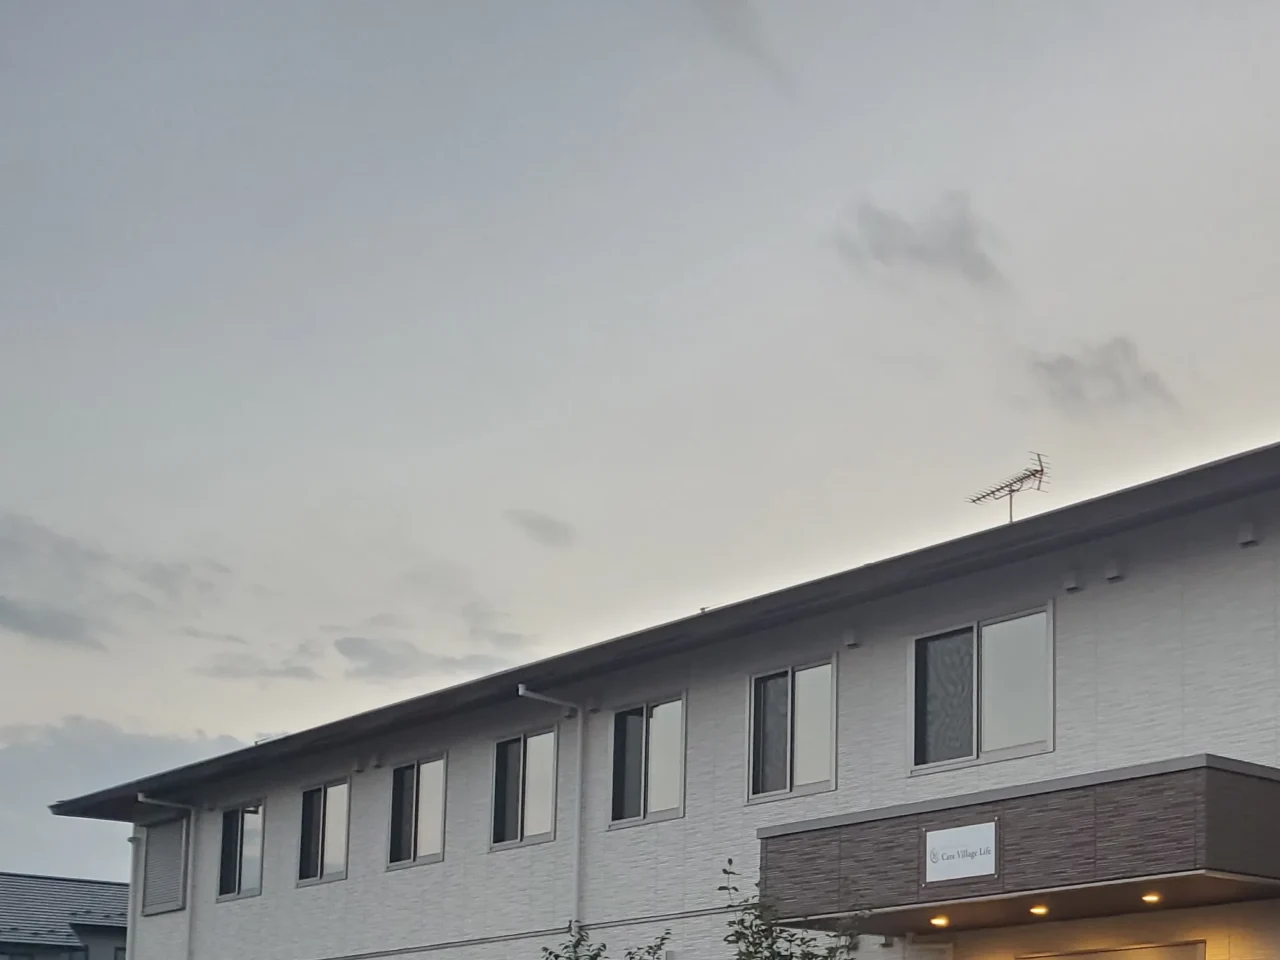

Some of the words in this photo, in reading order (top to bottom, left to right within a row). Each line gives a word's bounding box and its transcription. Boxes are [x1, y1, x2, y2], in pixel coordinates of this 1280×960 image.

[941, 852, 955, 861] Care
[957, 849, 978, 860] Village
[979, 846, 992, 856] Life
